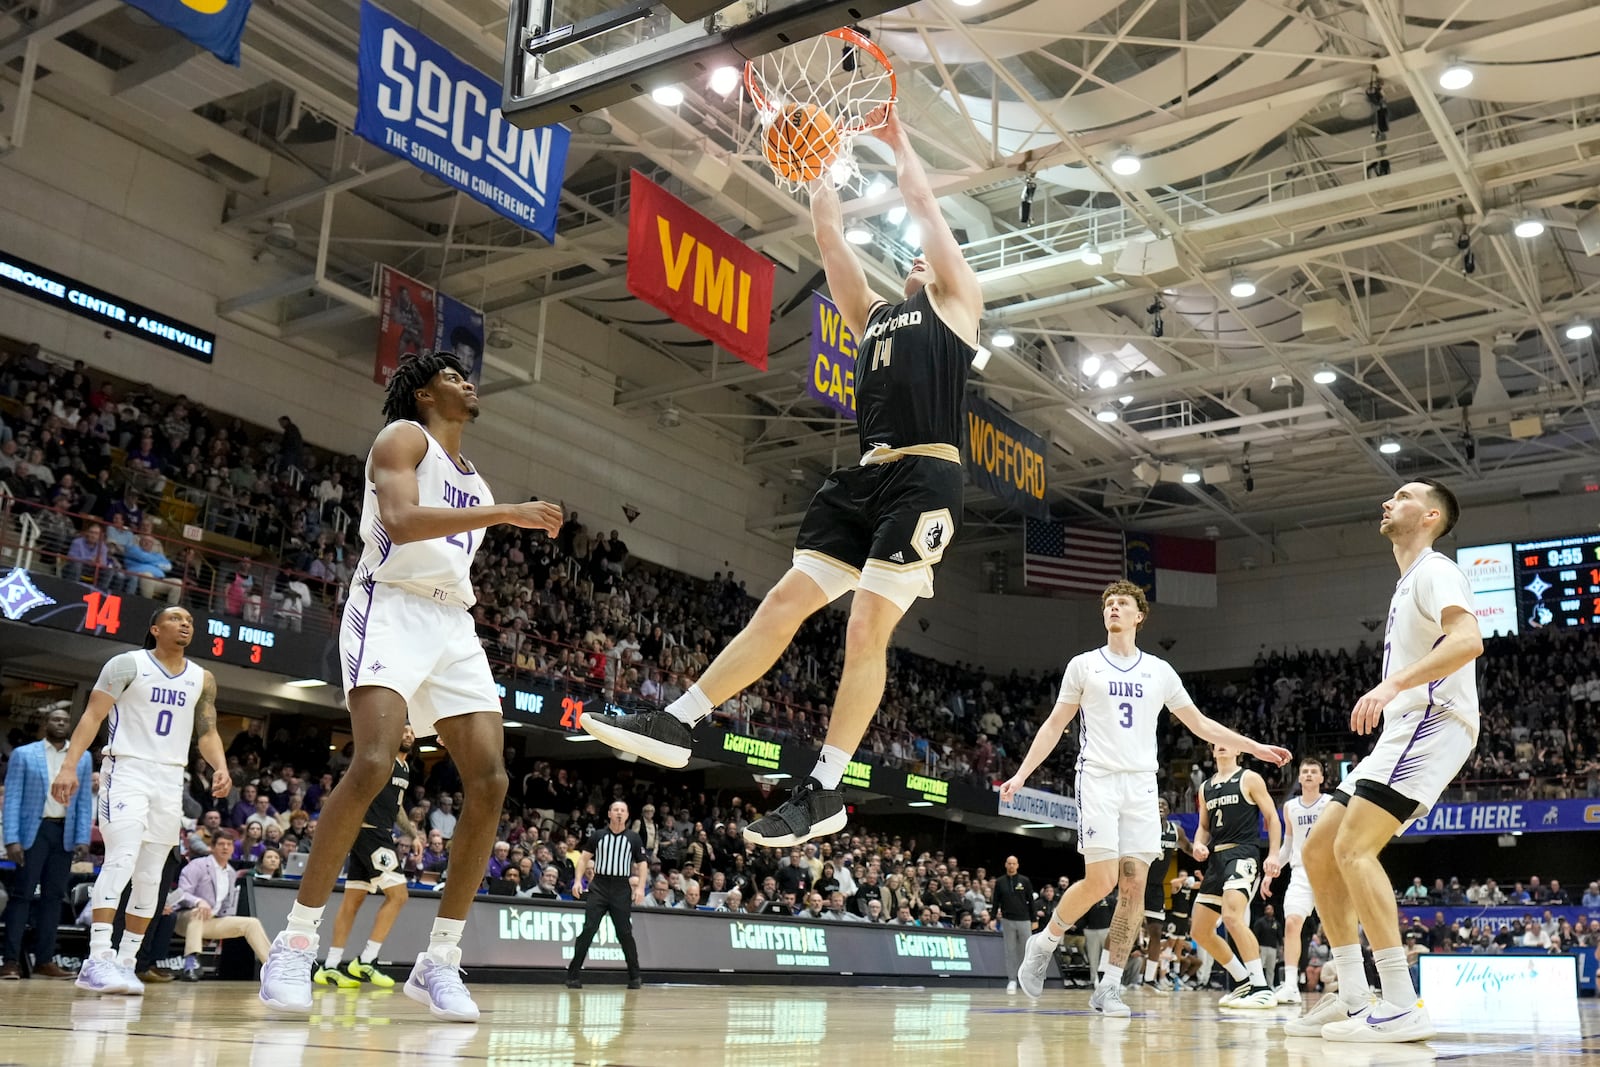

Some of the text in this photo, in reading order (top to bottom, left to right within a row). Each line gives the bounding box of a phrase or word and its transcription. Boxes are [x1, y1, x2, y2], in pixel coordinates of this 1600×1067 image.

[385, 127, 536, 223] THE SOUTHERN CONFERENCE
[656, 214, 751, 334] VMI
[68, 289, 126, 322] CENTER
[137, 317, 212, 354] ASHEVILLE
[872, 337, 892, 371] 14
[969, 411, 1046, 500] WOFFORD
[1524, 556, 1539, 567] 1ST
[1548, 547, 1583, 567] 9:55
[433, 588, 448, 601] FU
[83, 591, 122, 634] 14
[208, 618, 274, 648] TOs FOULS
[212, 637, 261, 664] 3 3
[150, 686, 187, 707] DINS
[1108, 681, 1143, 698] DINS
[155, 709, 173, 736] 0
[515, 690, 543, 714] WOF
[560, 697, 583, 730] 21
[1119, 702, 1133, 729] 3
[1013, 793, 1049, 817] SOUTHERN
[1206, 794, 1239, 810] OFFORD
[1431, 807, 1466, 830] ALL
[1470, 805, 1527, 829] HERE.
